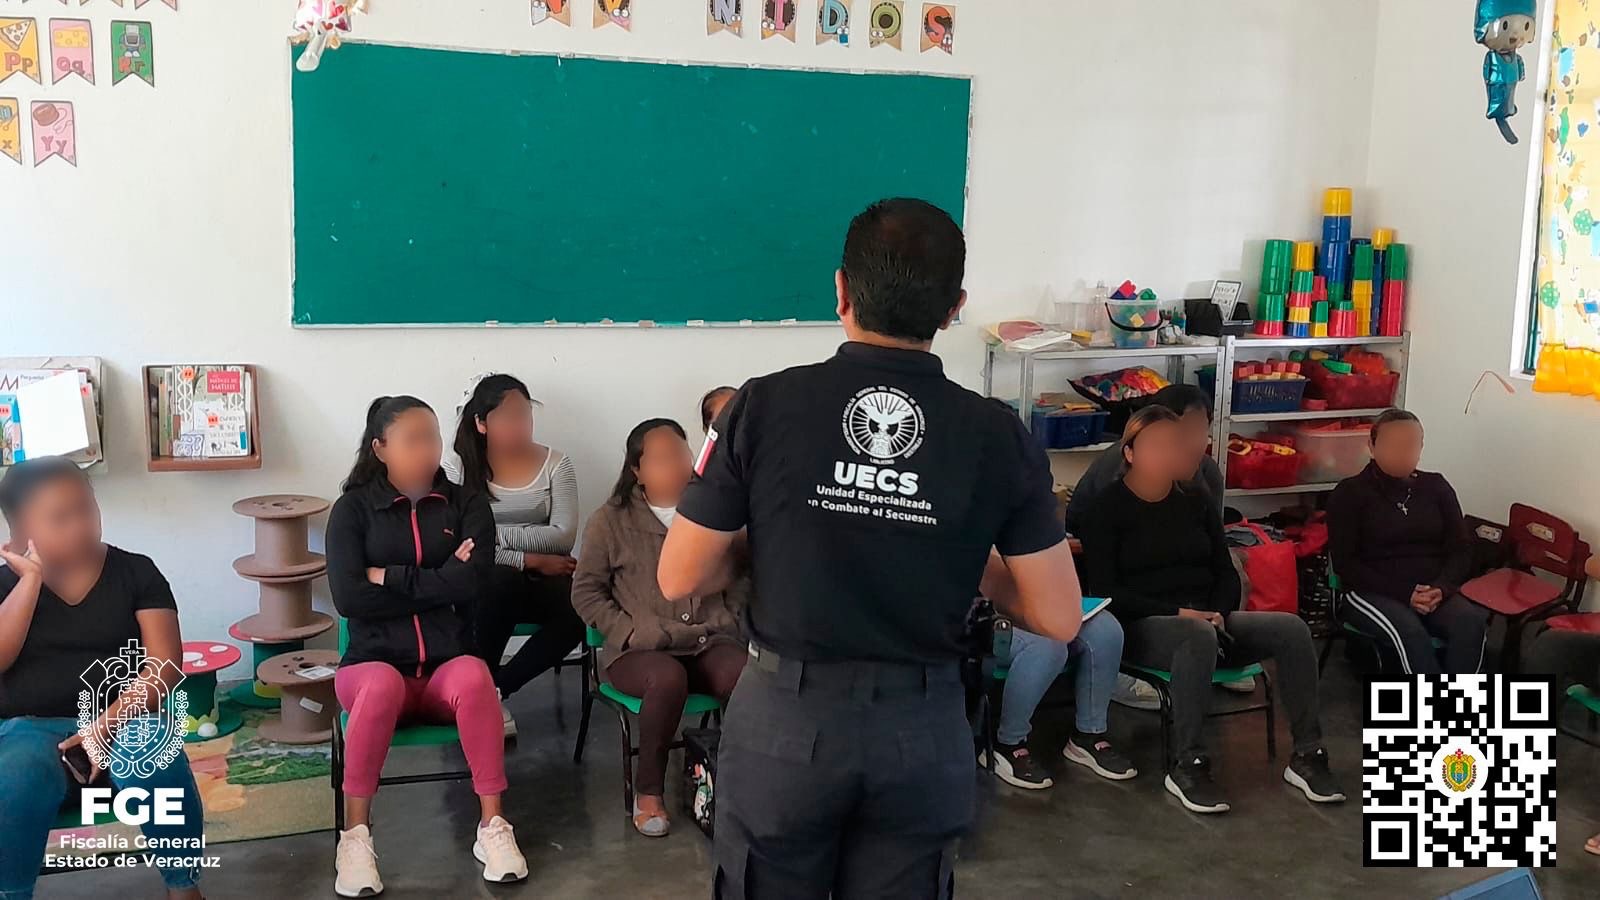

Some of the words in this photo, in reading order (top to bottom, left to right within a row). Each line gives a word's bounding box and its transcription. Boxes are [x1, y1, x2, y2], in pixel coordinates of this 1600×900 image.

[834, 461, 919, 496] UECS
[816, 484, 855, 499] Unidad
[857, 490, 932, 511] Especializada
[821, 500, 870, 515] Combate
[872, 508, 883, 517] al
